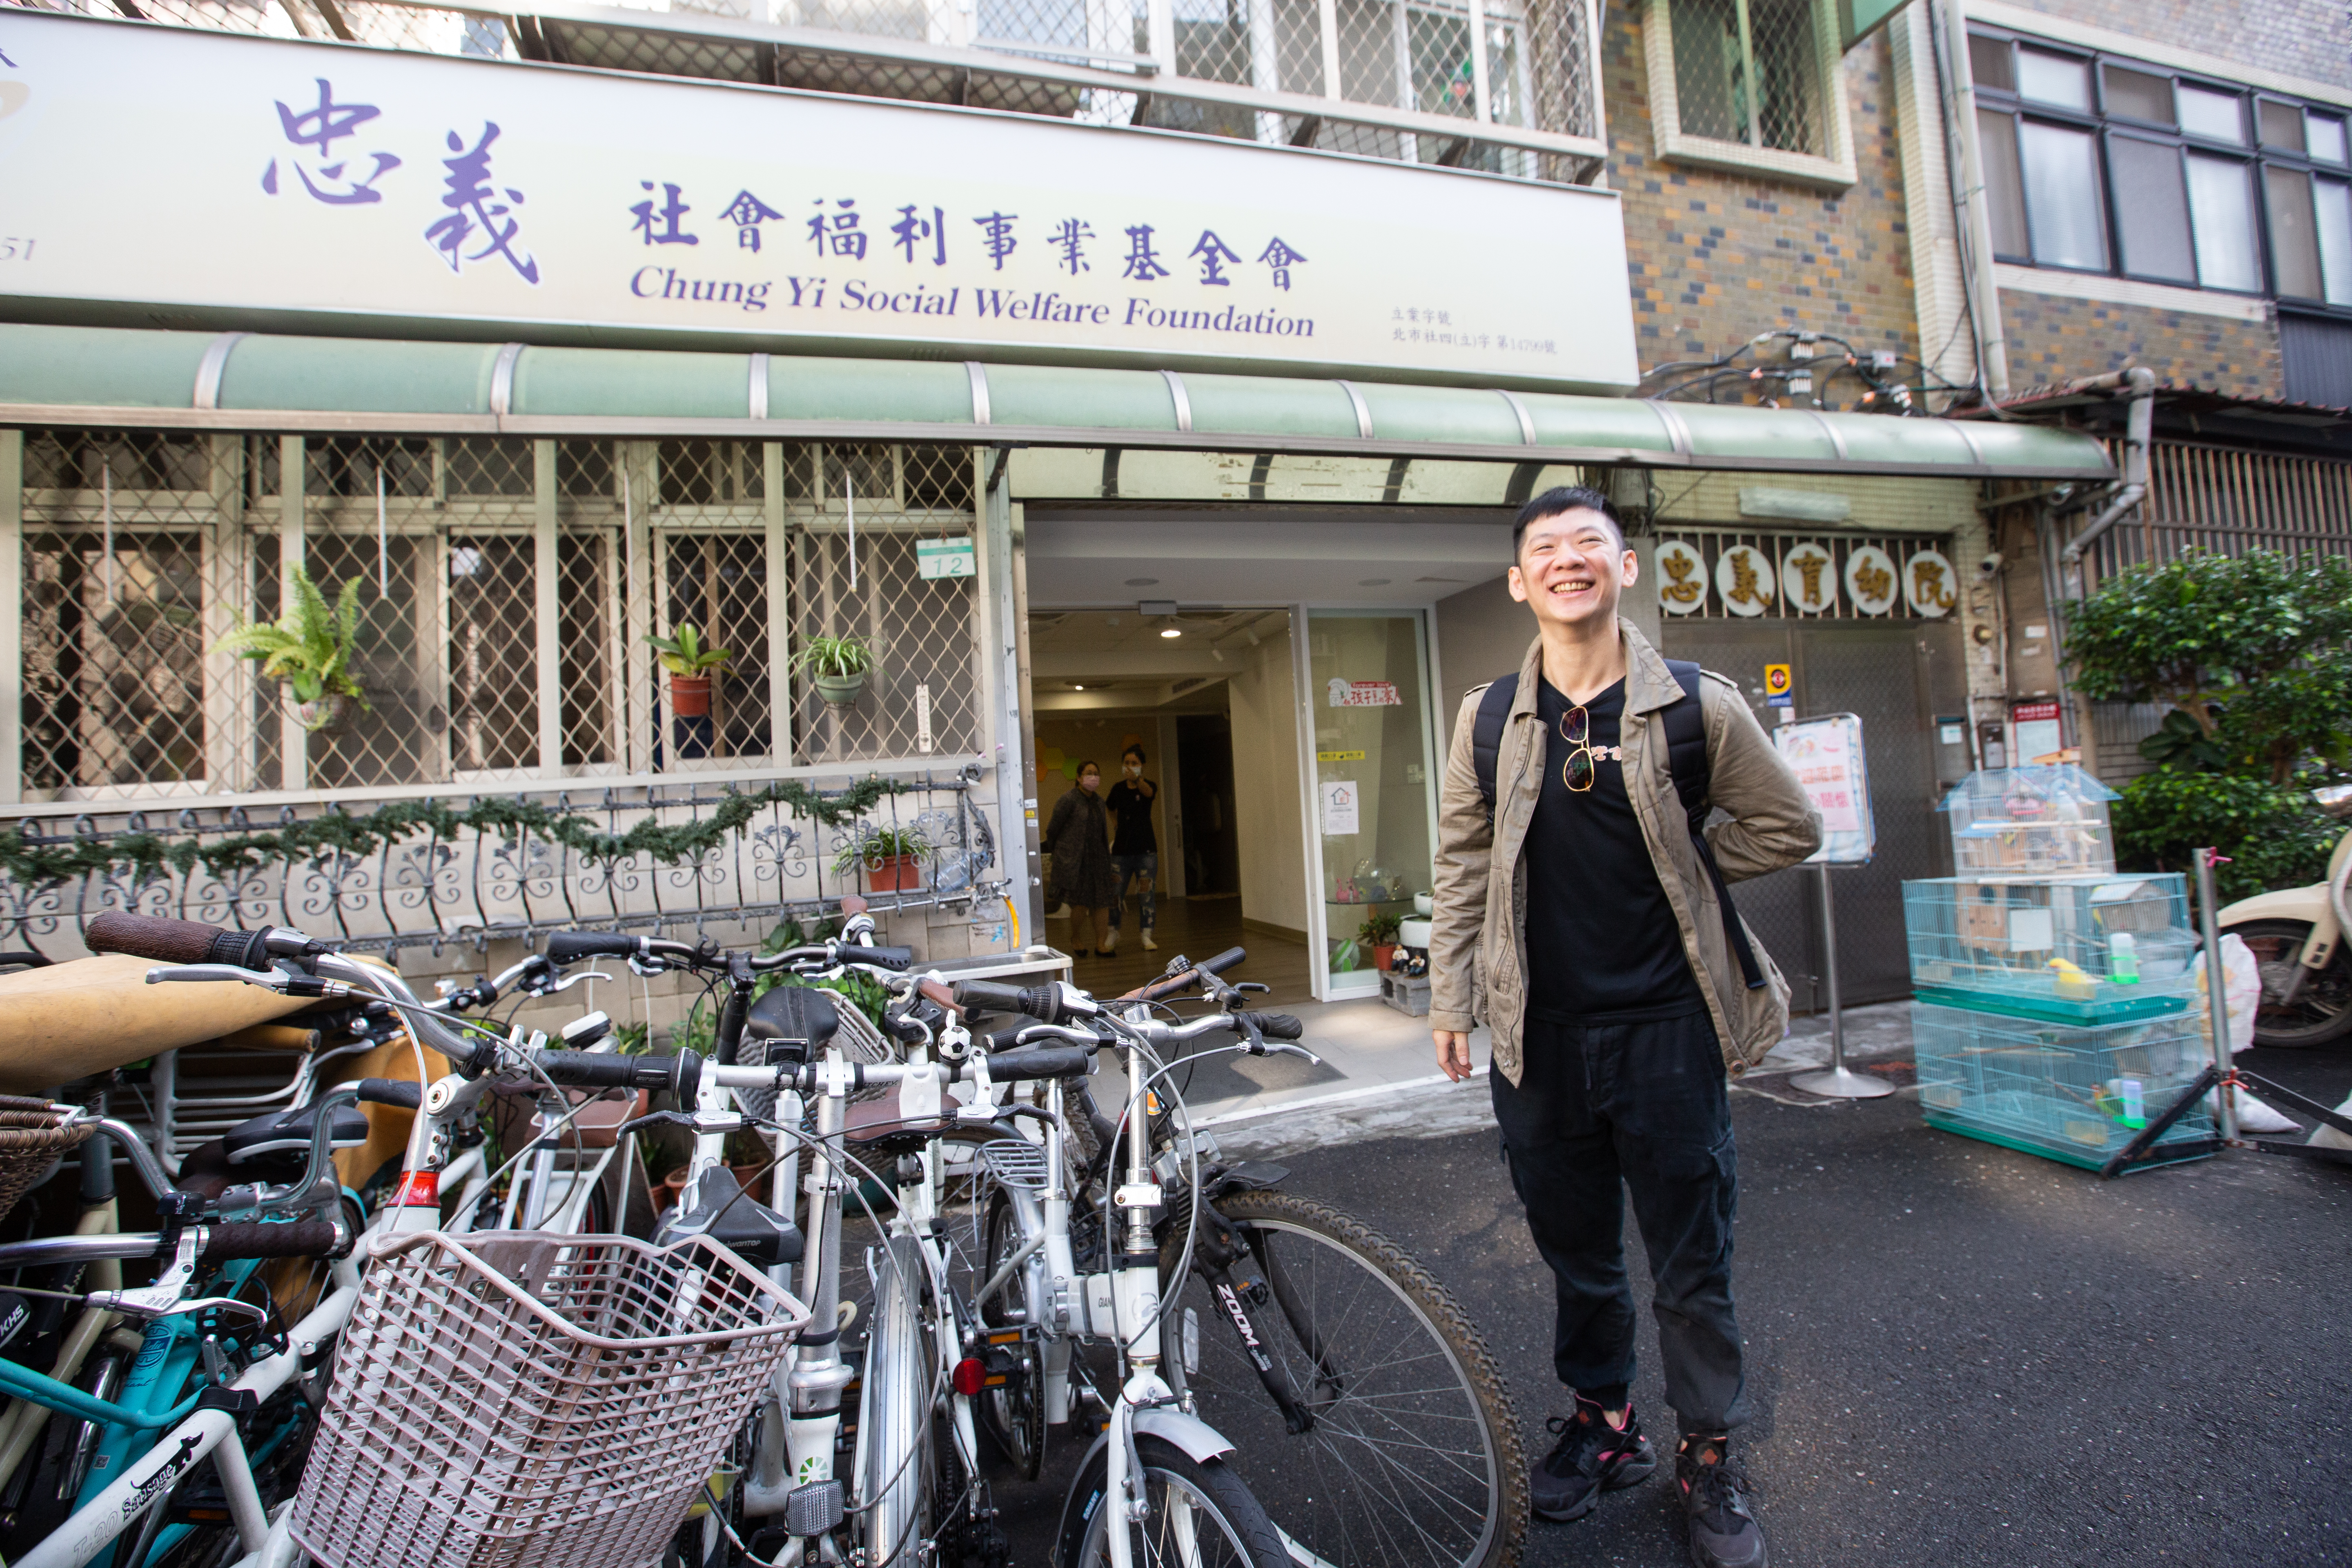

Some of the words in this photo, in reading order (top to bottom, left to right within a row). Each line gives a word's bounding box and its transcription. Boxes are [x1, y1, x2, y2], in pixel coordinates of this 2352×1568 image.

[261, 78, 540, 285] 忠義
[628, 180, 1309, 292] 社會福利事業基金會
[630, 265, 772, 312] Chung
[787, 276, 826, 308] Yi
[840, 278, 959, 315] Social
[975, 287, 1110, 324] Welfare
[1122, 297, 1314, 337] Foundation
[934, 557, 962, 575] 12
[1661, 549, 1955, 608] 忠義育幼院
[1071, 996, 1089, 1005] SHIMANO
[0, 1304, 24, 1337] KHS
[1217, 1284, 1260, 1345] ZOOM
[122, 1464, 173, 1522] Sausage
